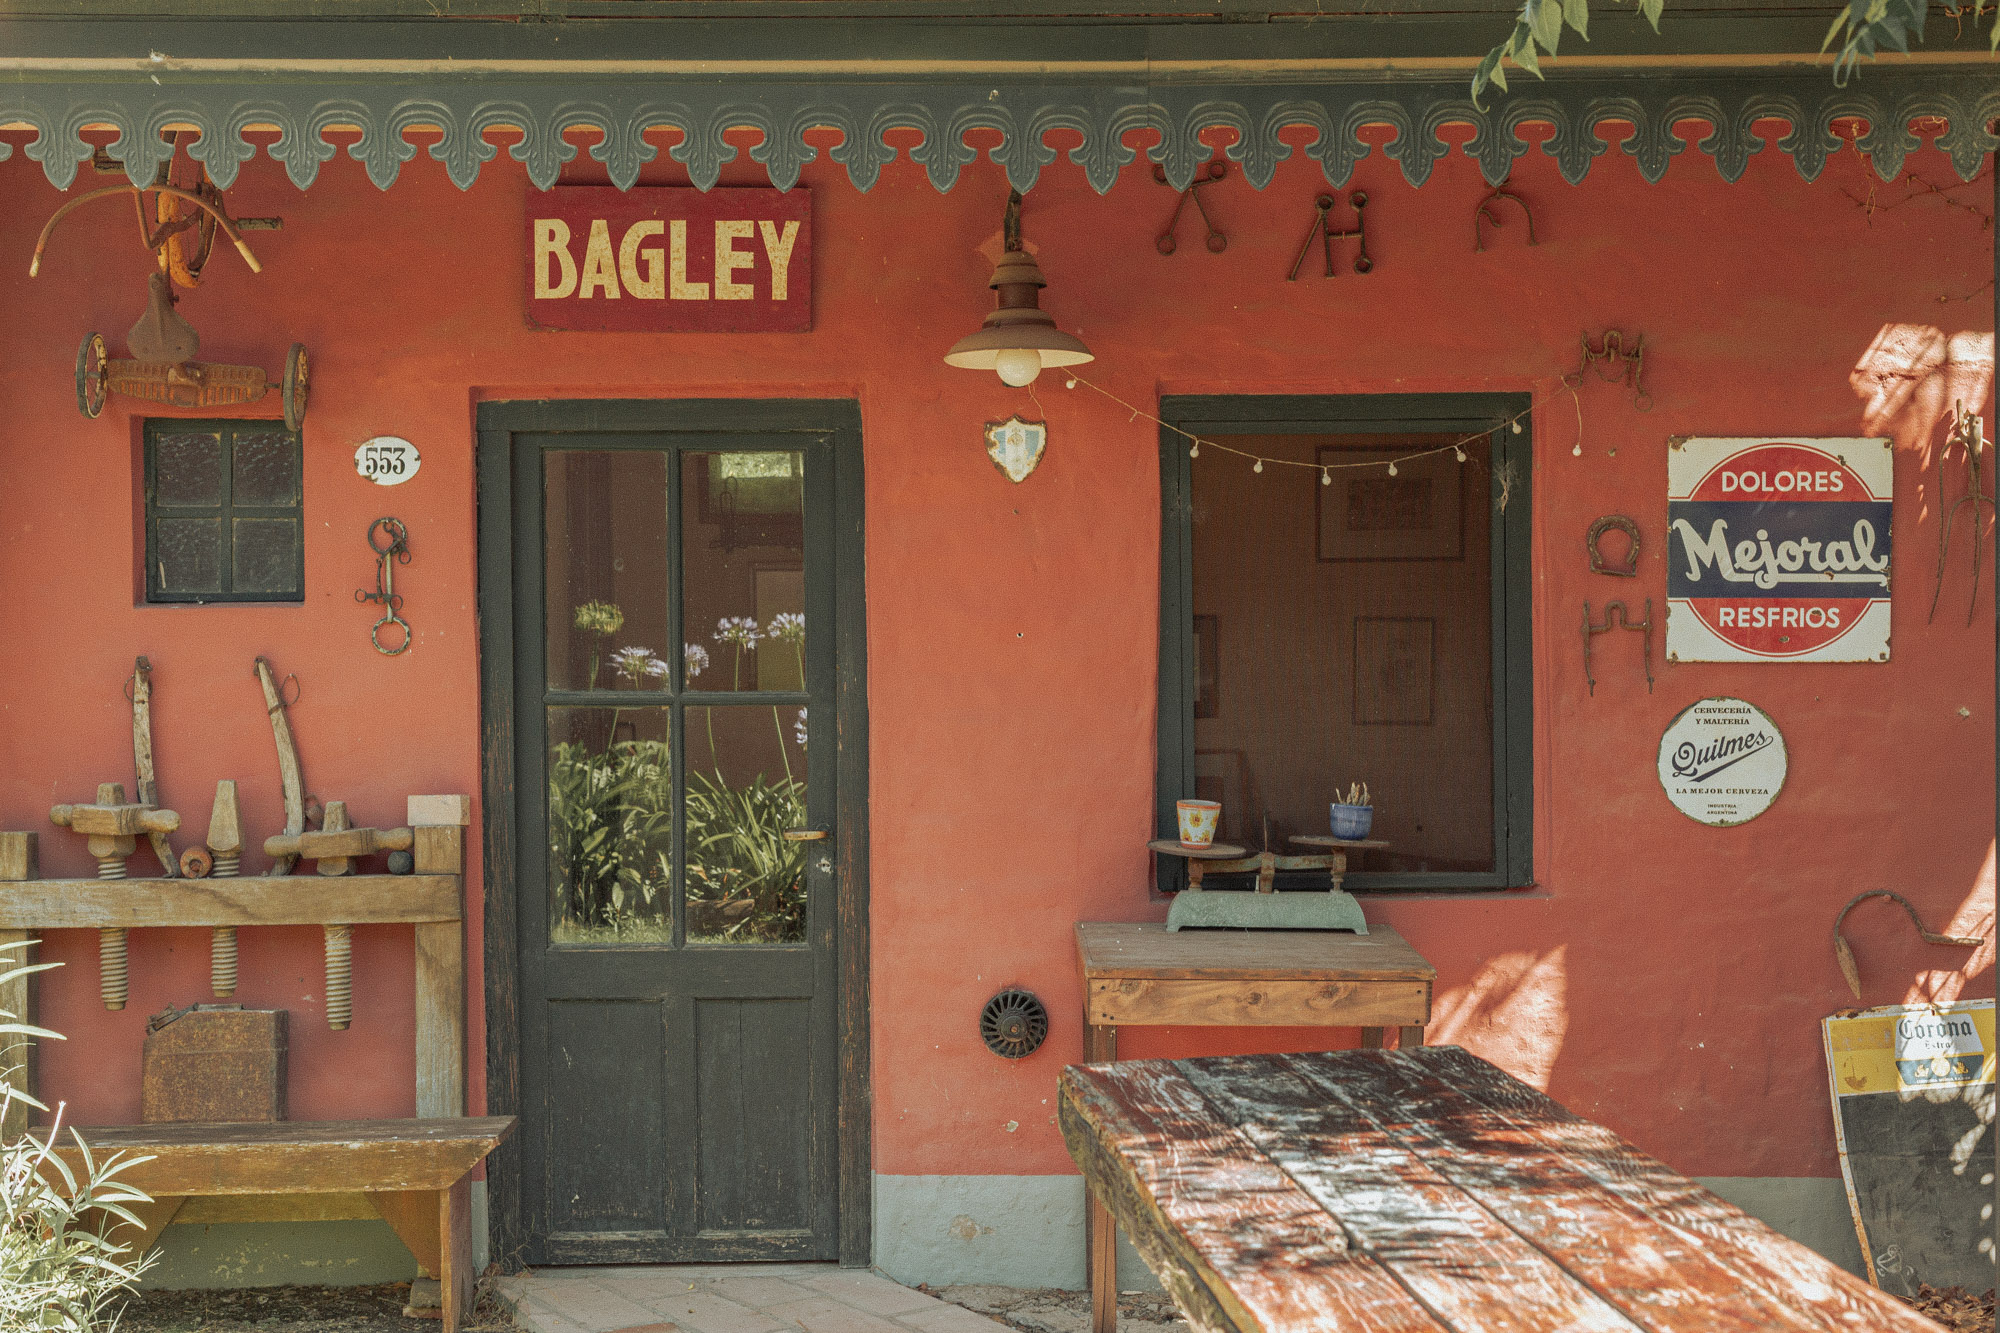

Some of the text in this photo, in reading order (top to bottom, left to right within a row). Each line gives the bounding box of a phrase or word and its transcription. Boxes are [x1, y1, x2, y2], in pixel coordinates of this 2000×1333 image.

[534, 218, 800, 300] BAGLEY
[365, 447, 406, 475] 553
[1721, 470, 1844, 493] DOLORES
[1672, 518, 1889, 590] Mejoral
[1718, 606, 1840, 629] RESFRIOS
[1694, 706, 1752, 714] CERVECERÍA
[1703, 717, 1750, 725] MALTERÍA
[1671, 730, 1773, 782] Quilmes
[1898, 1018, 1973, 1040] Corona
